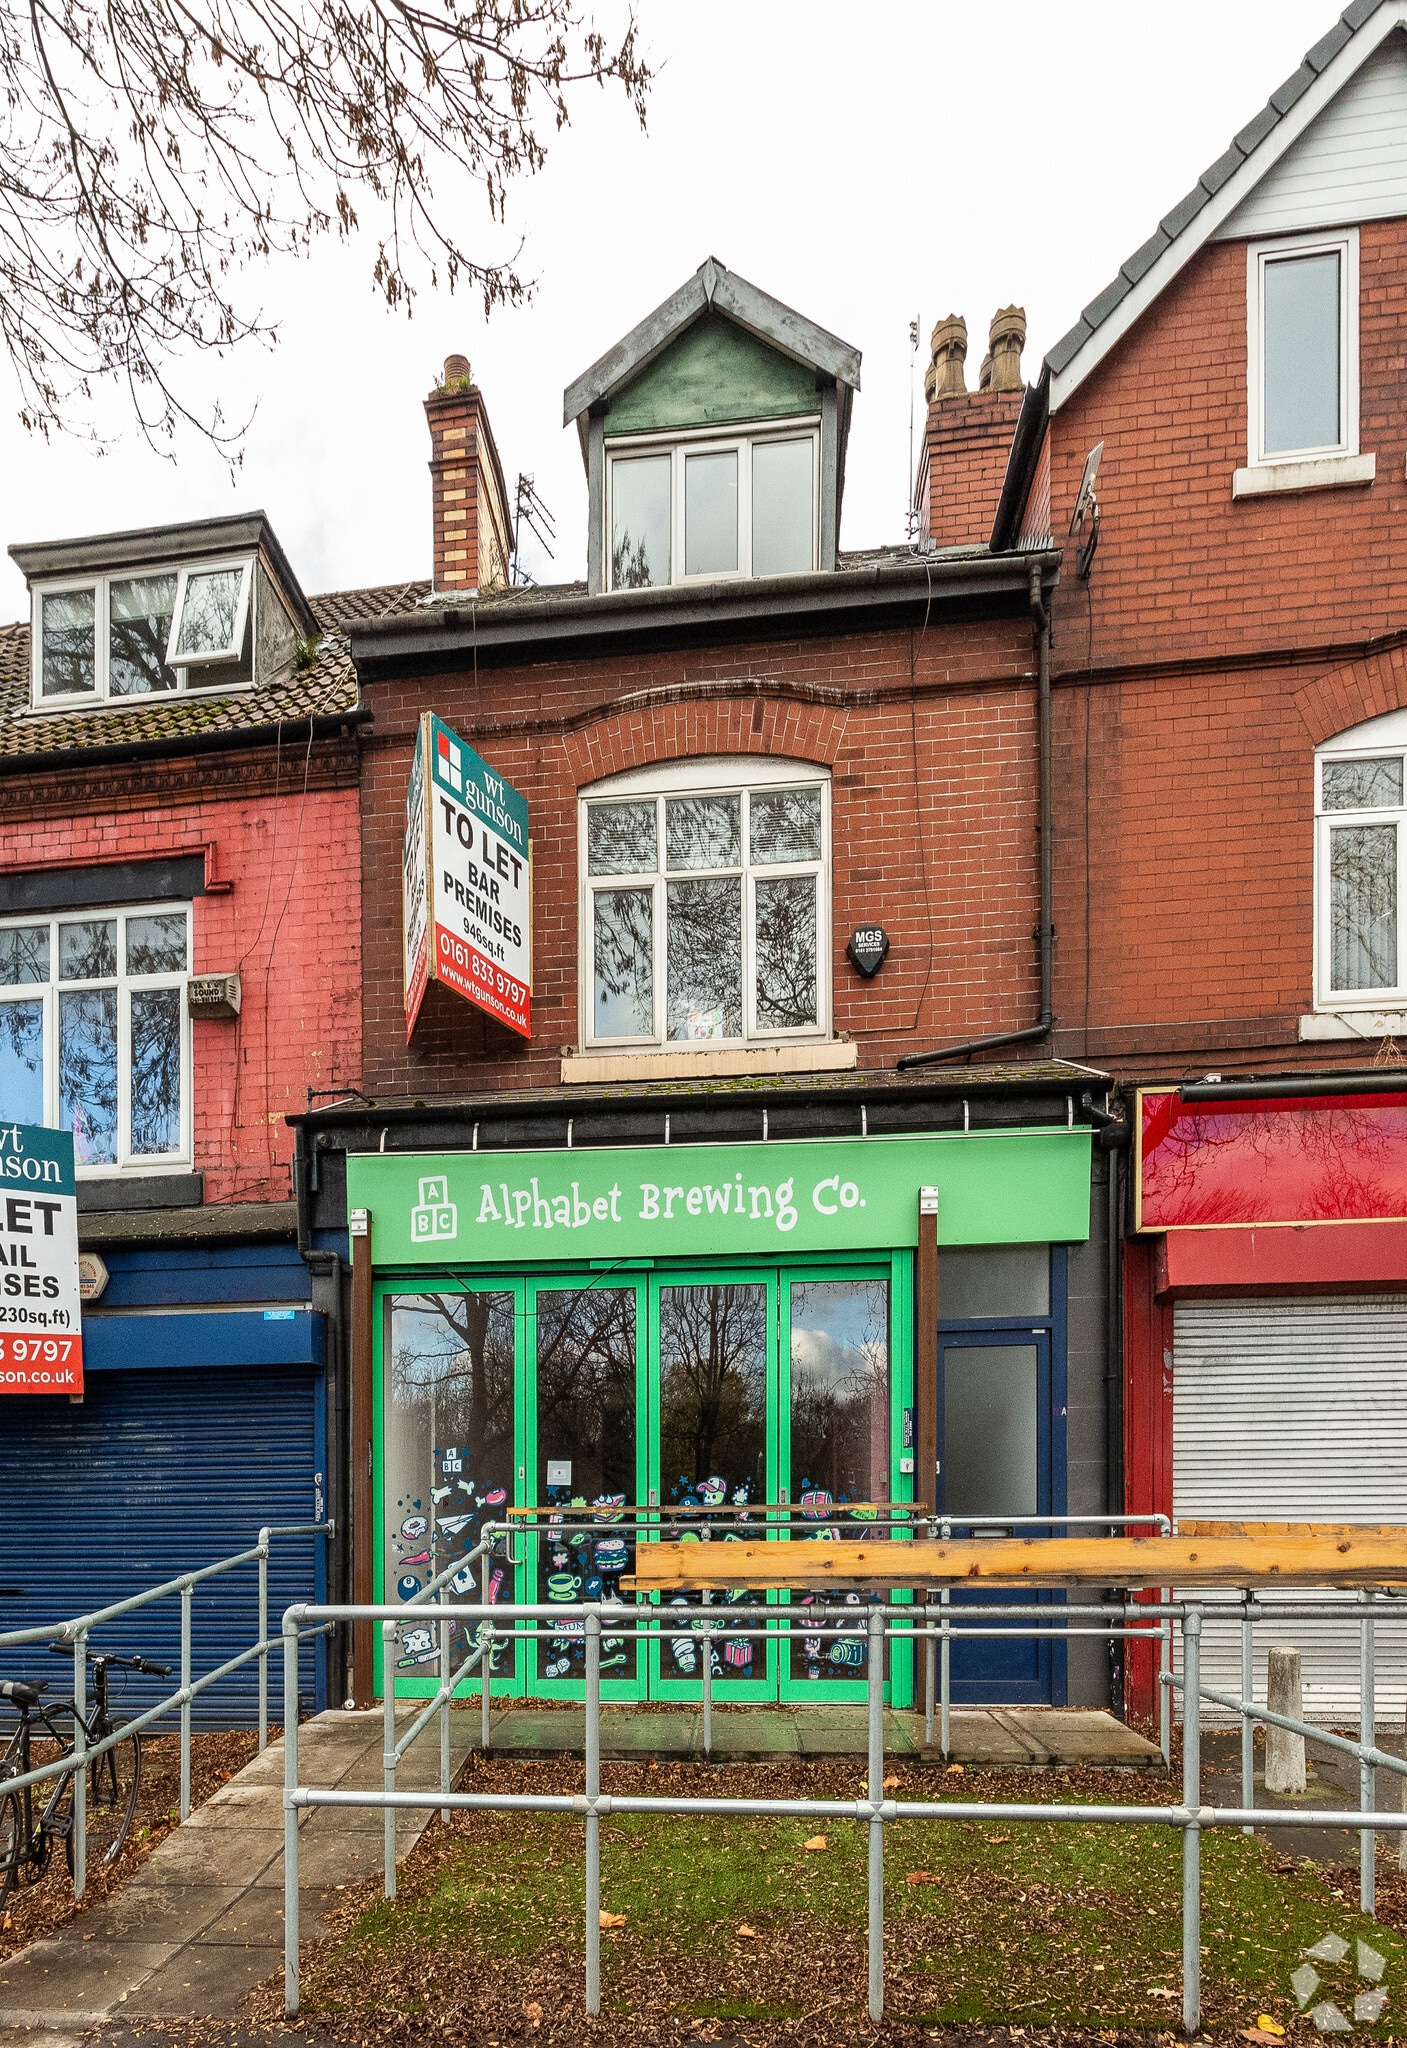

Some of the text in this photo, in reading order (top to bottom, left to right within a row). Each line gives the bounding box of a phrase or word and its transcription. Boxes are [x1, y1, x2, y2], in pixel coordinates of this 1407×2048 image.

[484, 771, 505, 806] wt
[466, 779, 522, 845] gunson
[440, 795, 474, 850] TO
[483, 830, 522, 890] LET
[468, 860, 500, 905] BAR
[443, 870, 522, 948] PREMISES
[463, 917, 505, 962] 946sq.ft
[855, 930, 882, 943] MGS
[440, 932, 526, 1007] 0161 833 9797
[194, 988, 220, 997] SOUND
[440, 962, 527, 1028] www.wtgunson.co.uk
[0, 1198, 62, 1236] ET
[475, 1172, 867, 1232] Alphabet Brewing Co.
[0, 1273, 60, 1298] SES
[12, 1339, 73, 1362] 9797
